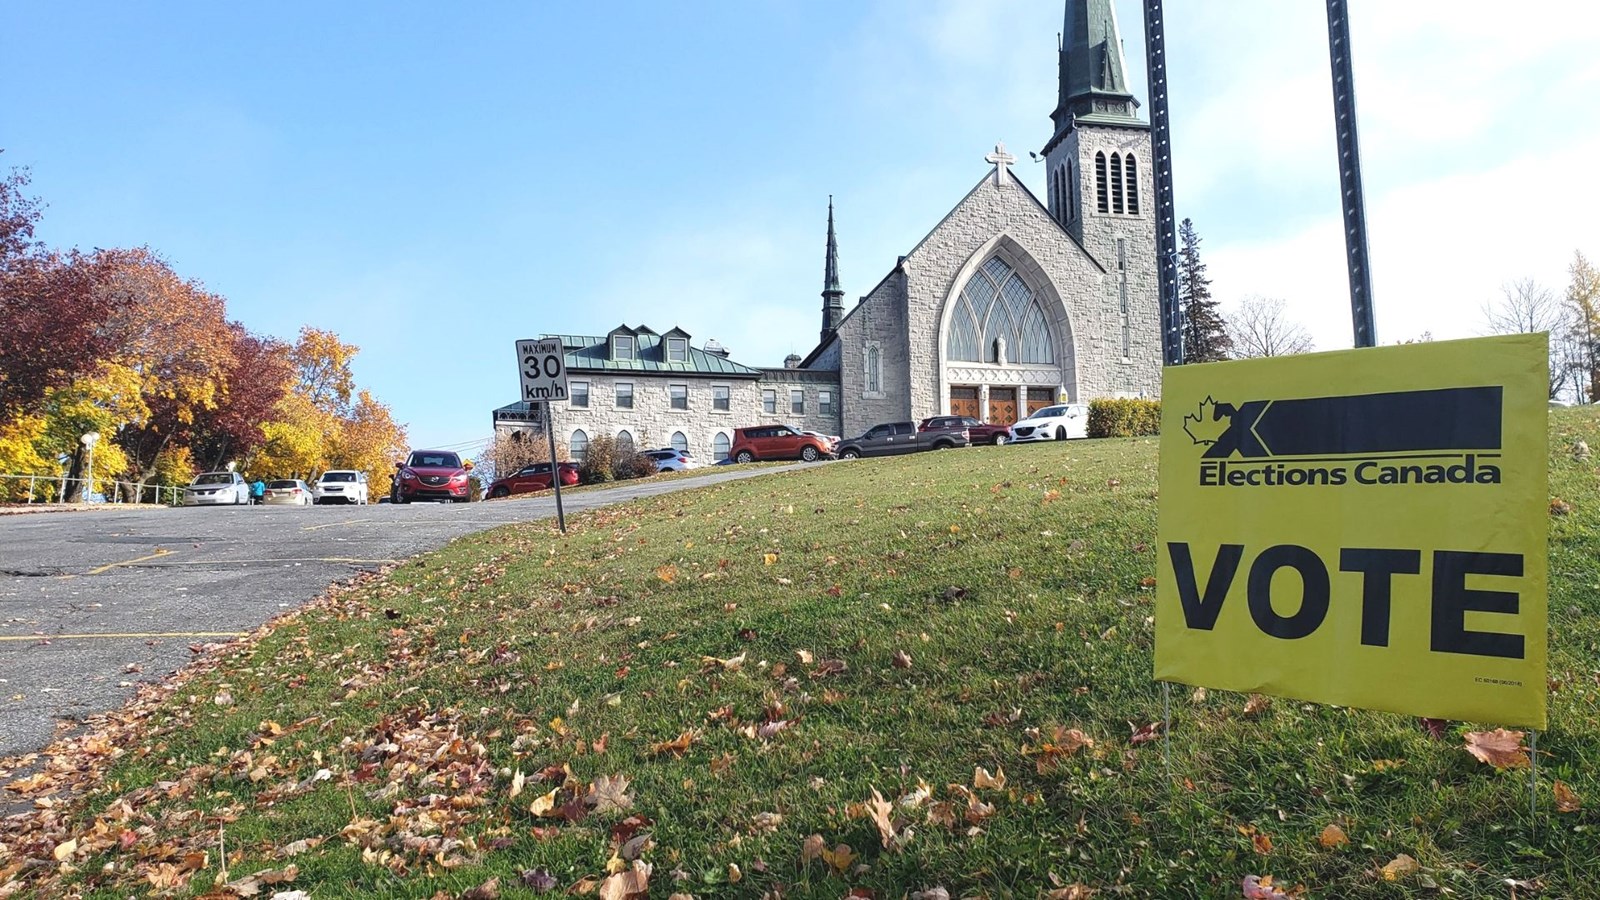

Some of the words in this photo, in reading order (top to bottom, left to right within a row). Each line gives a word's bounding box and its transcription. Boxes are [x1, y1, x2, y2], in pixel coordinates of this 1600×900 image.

[523, 344, 557, 354] MAXIMUM
[524, 355, 561, 379] 30
[525, 380, 564, 398] km/h
[1199, 461, 1347, 486] Elections
[1354, 454, 1502, 484] Canada
[1167, 542, 1525, 659] VOTE
